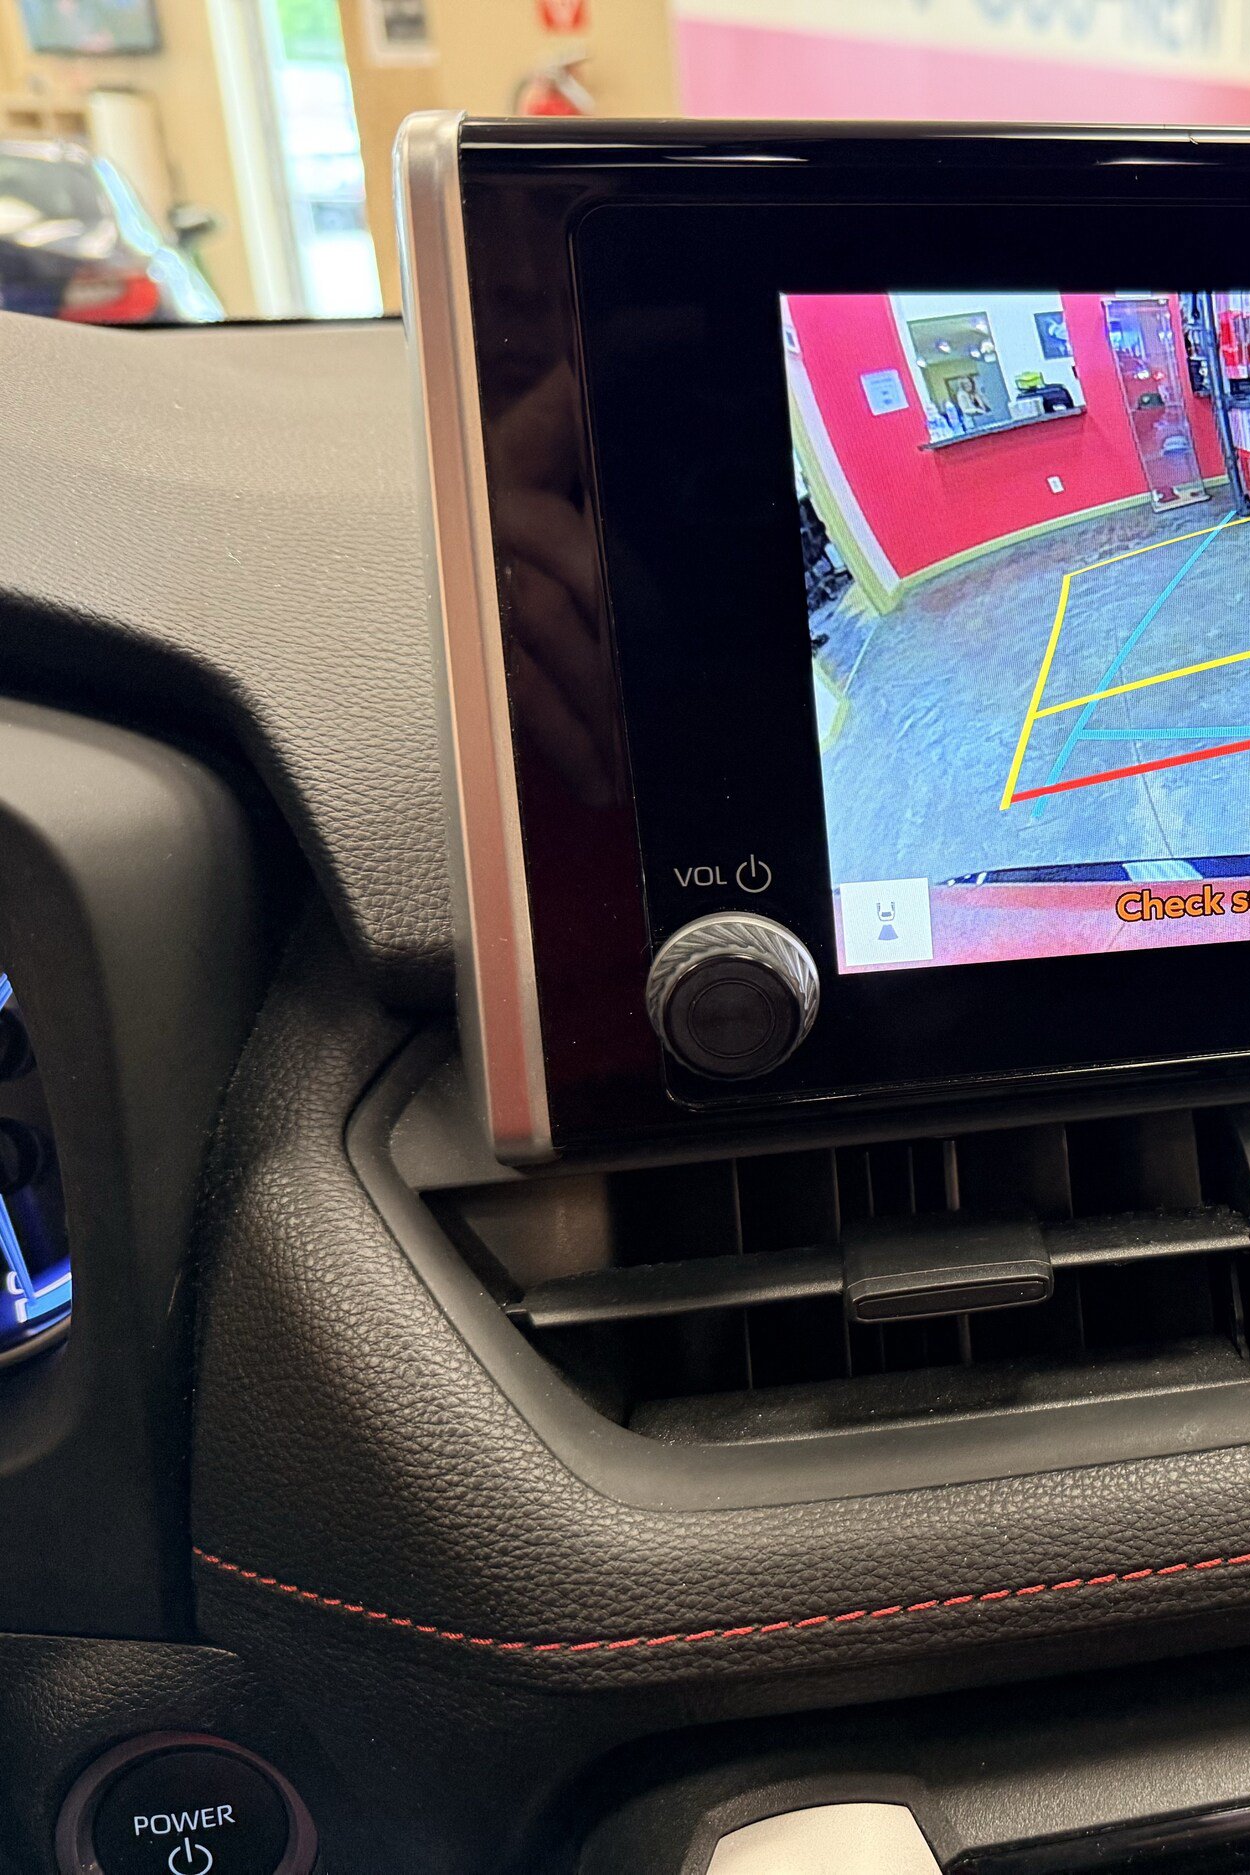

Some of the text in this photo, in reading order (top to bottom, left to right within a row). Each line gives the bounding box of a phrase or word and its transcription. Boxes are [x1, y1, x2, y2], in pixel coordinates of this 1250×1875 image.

[673, 866, 728, 888] VOL
[1116, 886, 1224, 921] Check
[133, 1804, 236, 1837] POWER
